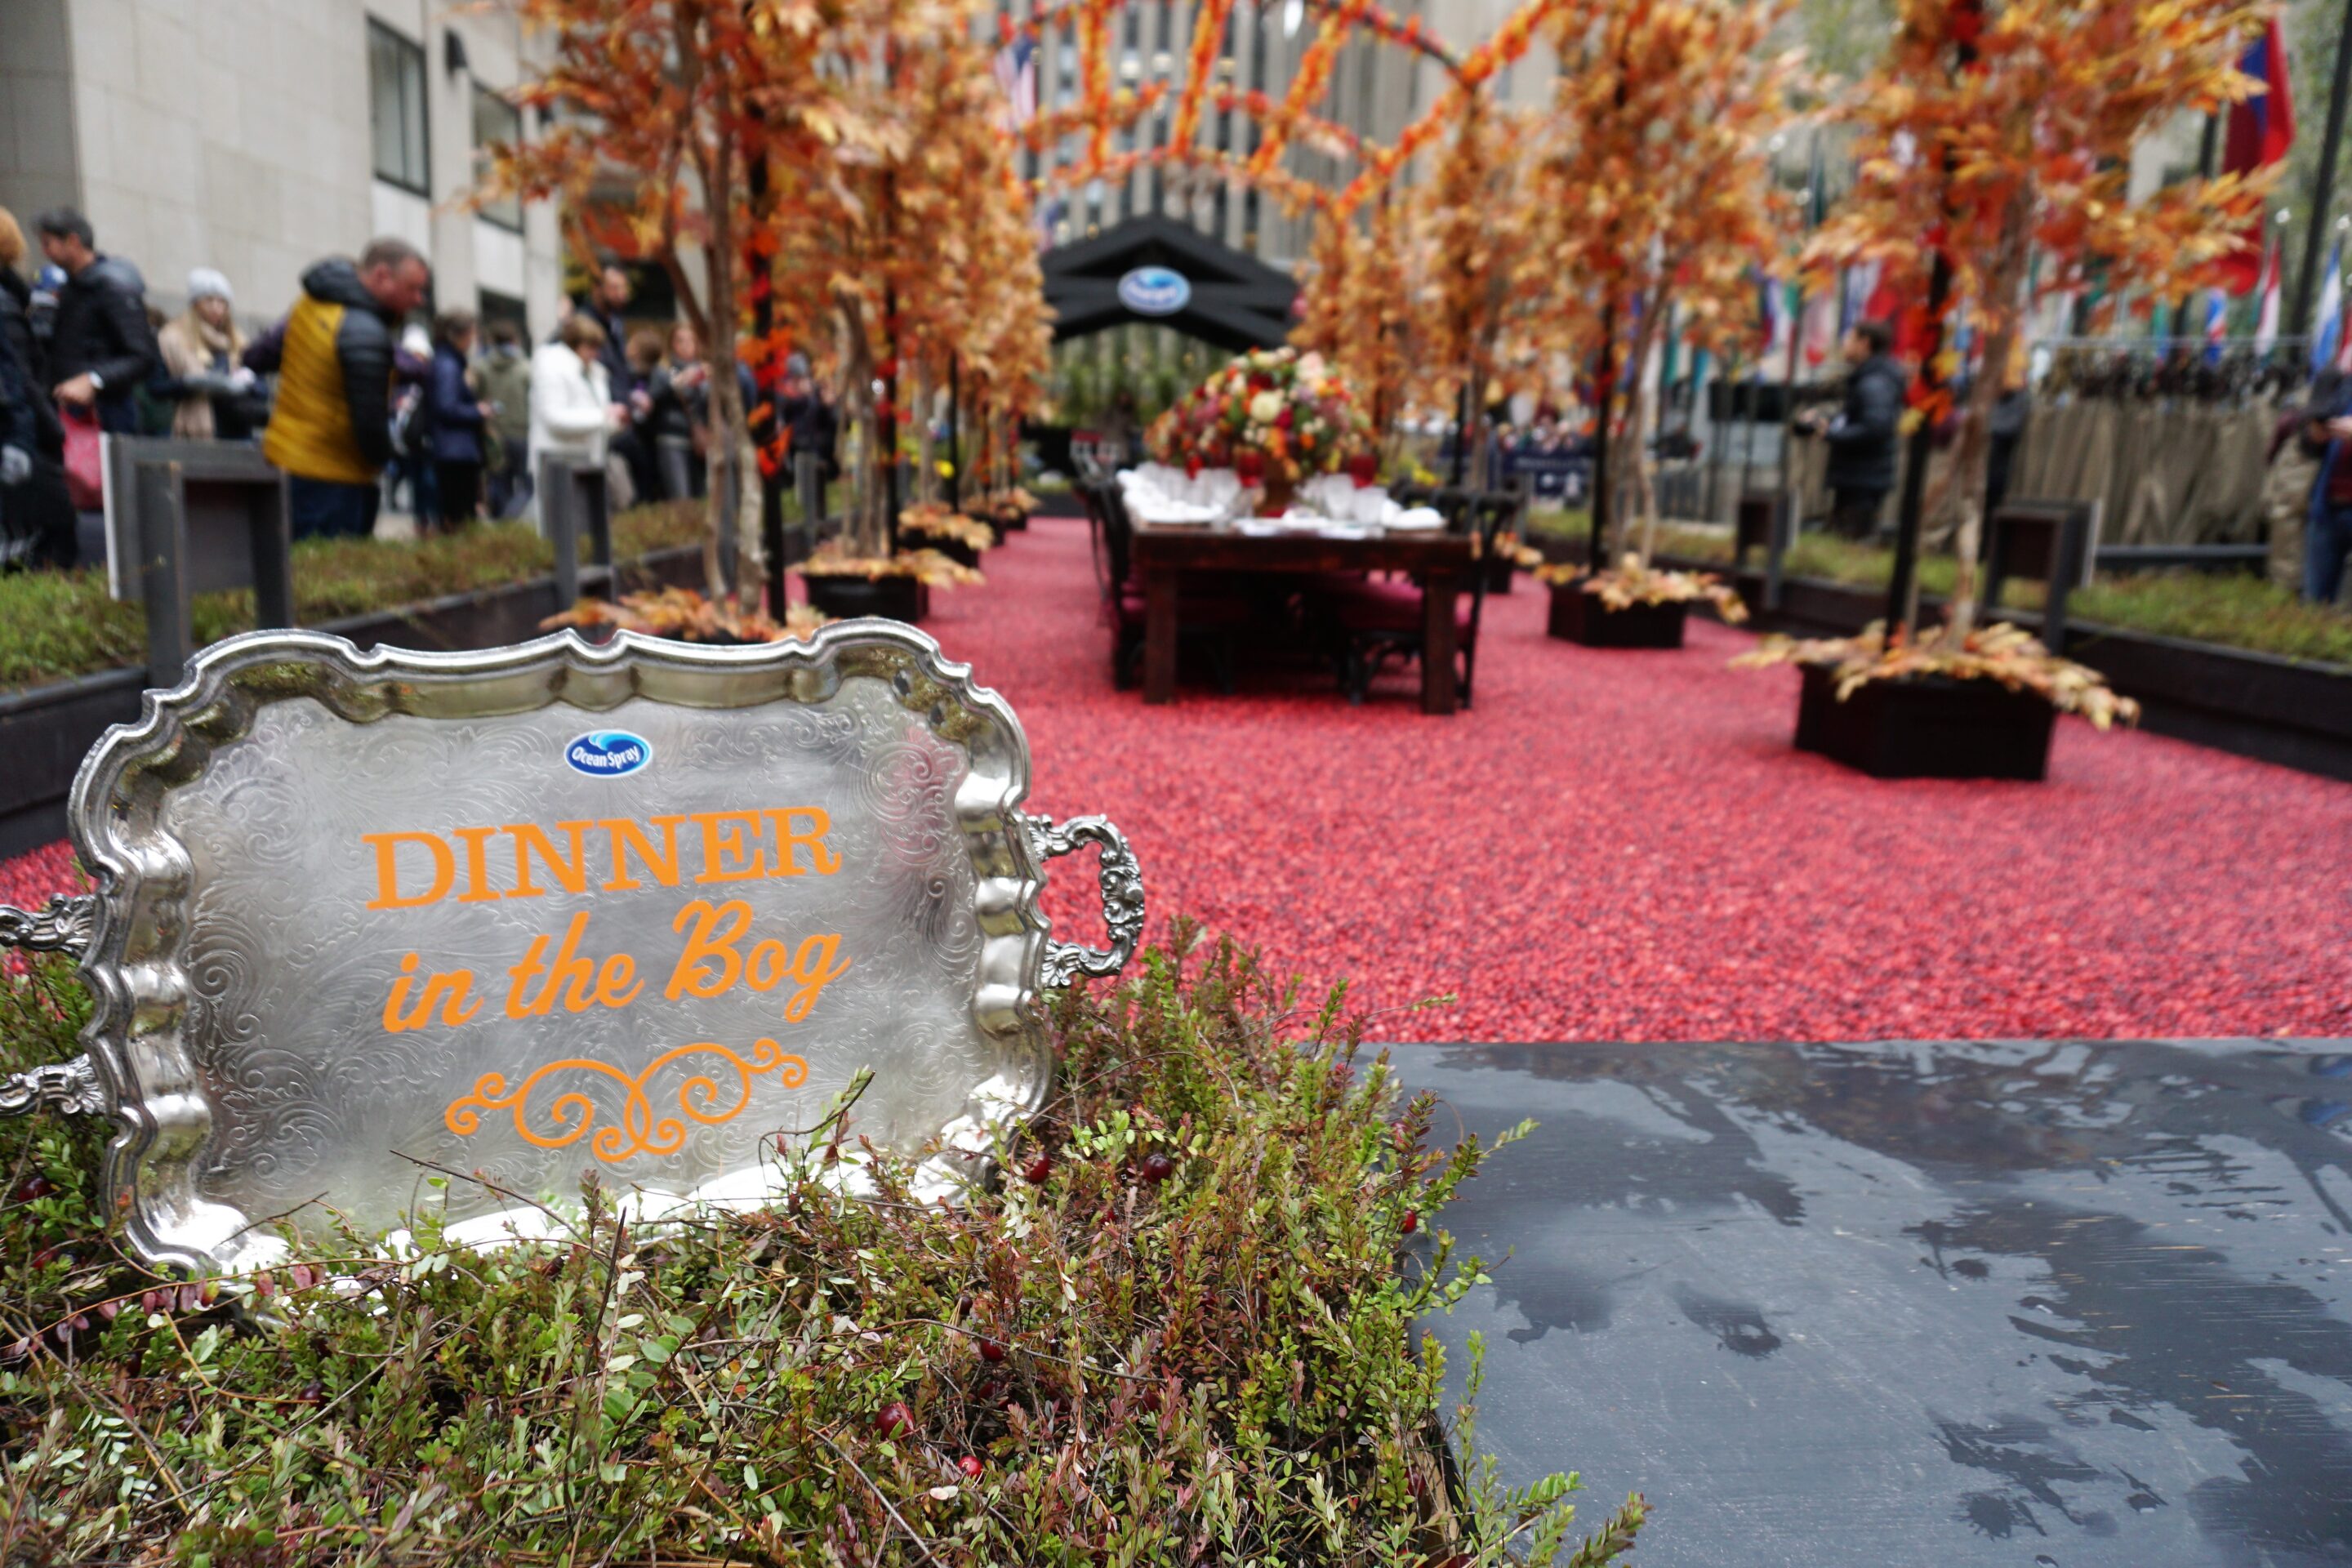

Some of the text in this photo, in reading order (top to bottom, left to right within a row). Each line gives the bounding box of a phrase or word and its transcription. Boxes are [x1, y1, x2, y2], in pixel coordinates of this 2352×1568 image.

[572, 745, 640, 769] Ocean Spray
[362, 806, 843, 910] DINNER
[381, 899, 852, 1033] in the Bog
